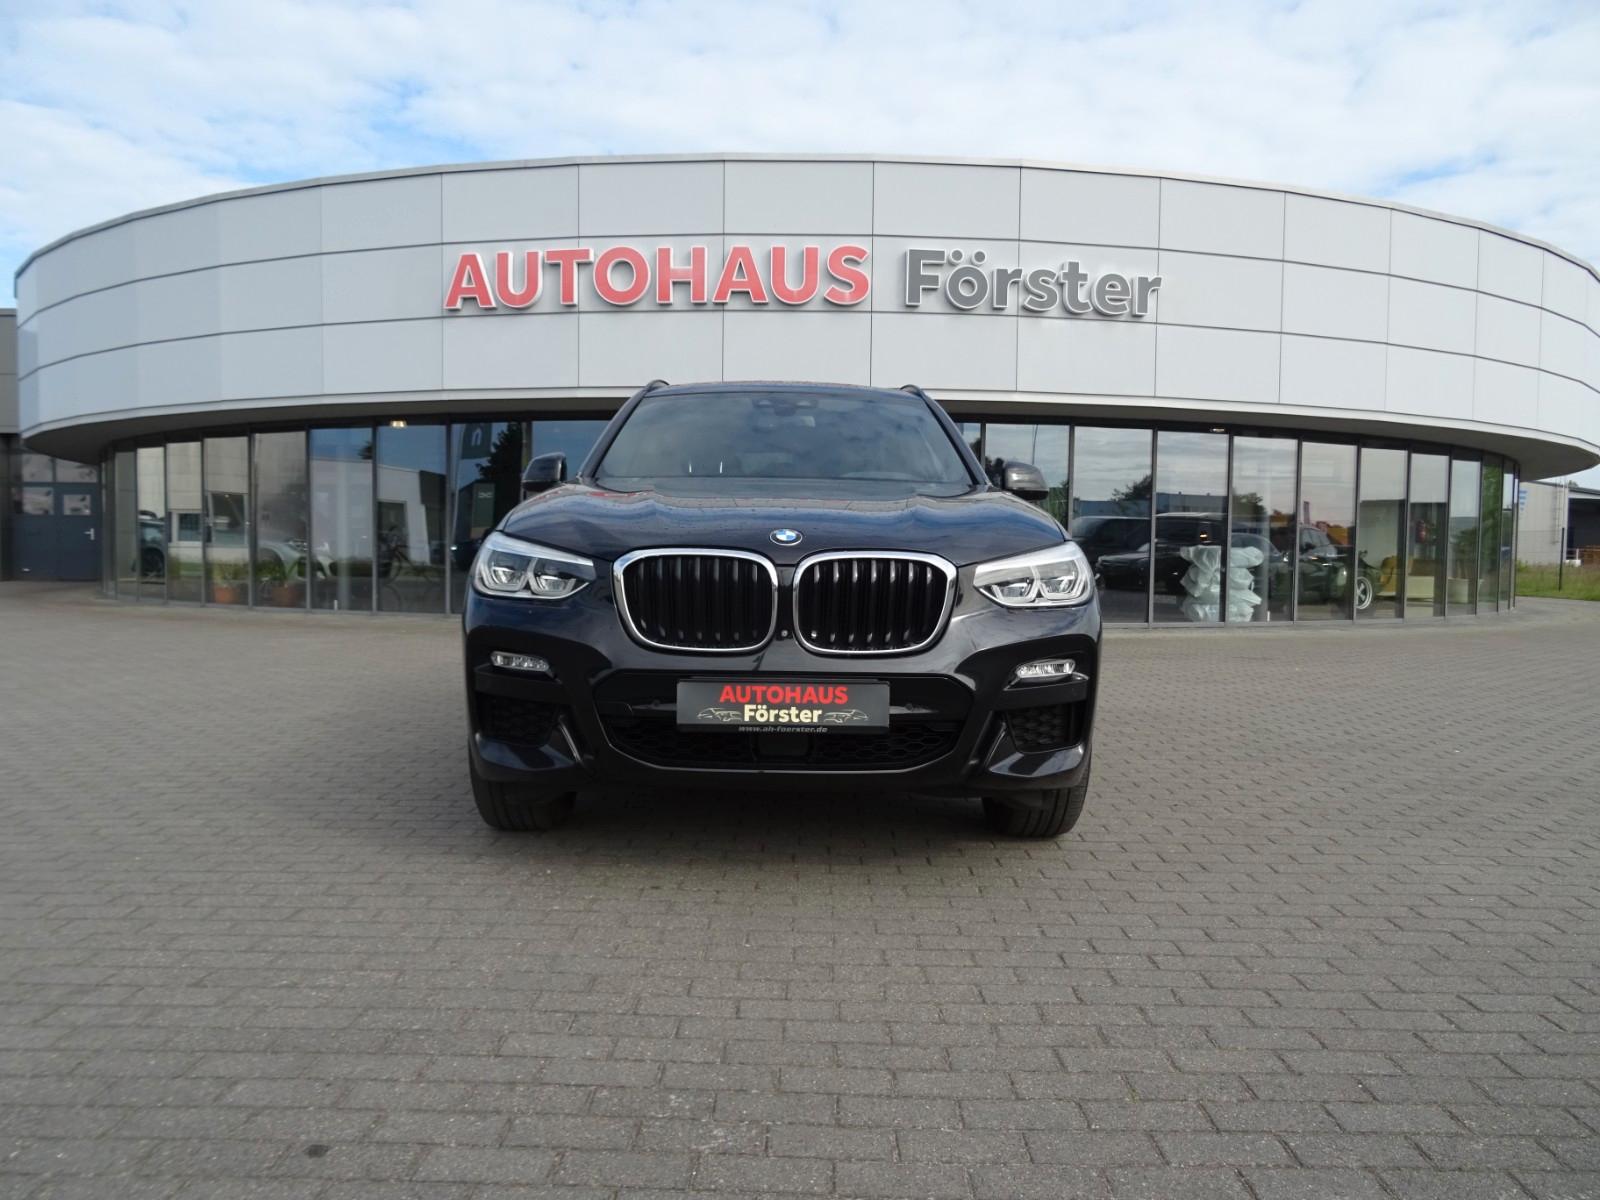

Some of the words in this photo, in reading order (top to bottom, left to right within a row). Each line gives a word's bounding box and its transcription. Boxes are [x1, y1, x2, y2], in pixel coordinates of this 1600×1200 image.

[444, 245, 872, 311] AUTOHAUS
[904, 247, 1162, 316] Förster
[719, 685, 849, 704] AUTOHAUS
[743, 704, 823, 723] Förster
[738, 725, 828, 734] www.ah-foerster.de
